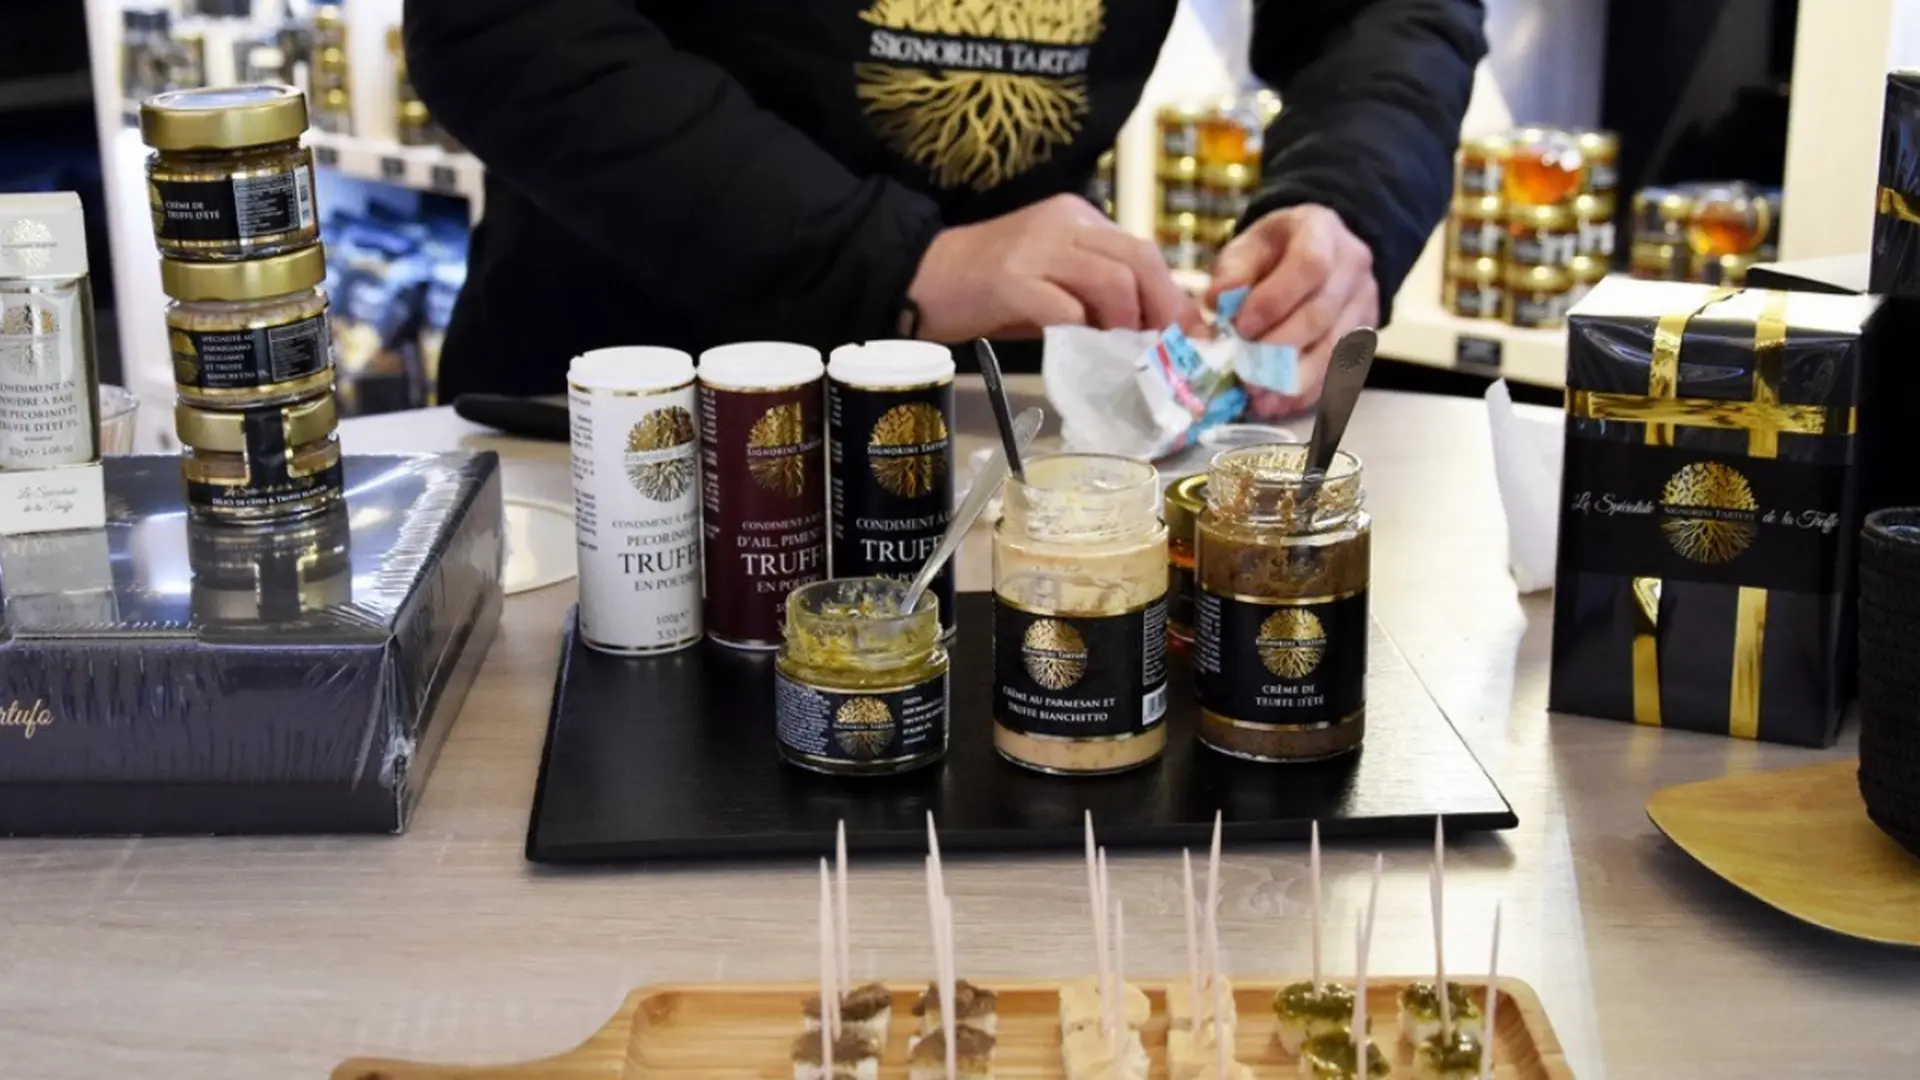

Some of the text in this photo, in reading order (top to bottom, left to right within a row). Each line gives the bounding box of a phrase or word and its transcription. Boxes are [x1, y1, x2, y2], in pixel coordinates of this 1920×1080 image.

[869, 29, 1004, 69] SIGNORINI
[868, 445, 919, 456] SIGNORINI
[741, 517, 802, 531] CONDIMENT
[855, 516, 935, 532] CONDIMENT
[1261, 684, 1298, 695] CRÈME
[1028, 694, 1043, 704] AU
[1044, 697, 1100, 708] PARMESAN
[1103, 696, 1116, 707] ET
[1039, 711, 1109, 723] BIANCHETTO
